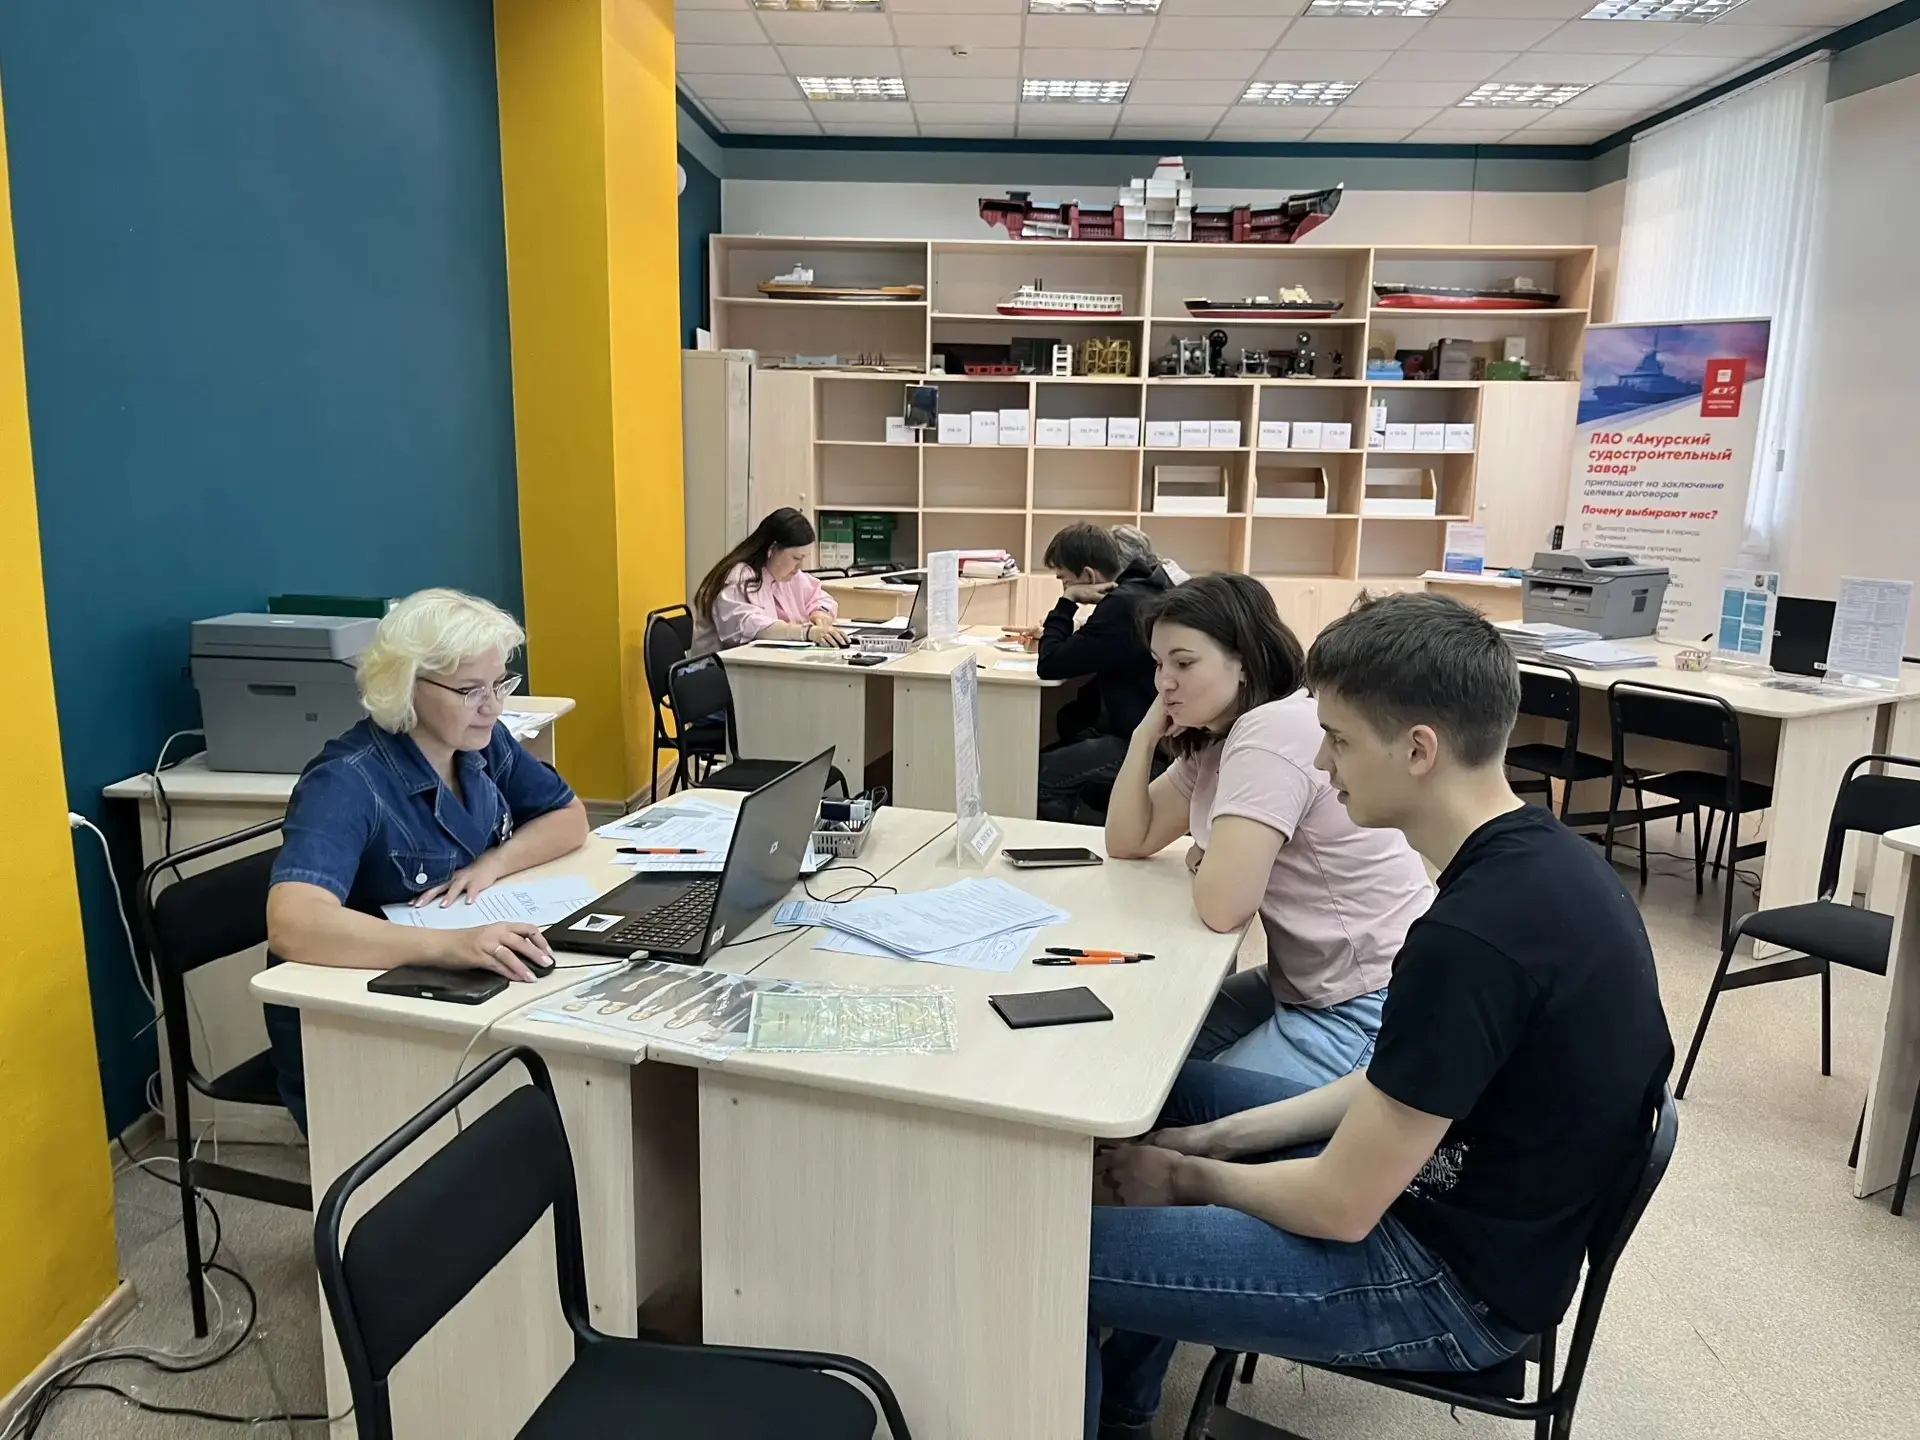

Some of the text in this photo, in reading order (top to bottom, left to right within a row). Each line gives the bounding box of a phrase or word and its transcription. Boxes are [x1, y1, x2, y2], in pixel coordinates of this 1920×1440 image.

[1590, 433, 1711, 447] ПАО «Амурский
[1588, 449, 1732, 462] судостроительный
[1586, 464, 1637, 475] завод»
[1584, 479, 1724, 489] приглашает на заключение
[1583, 489, 1679, 499] целевых договоров
[1581, 505, 1718, 519] Почему выбирают нас?
